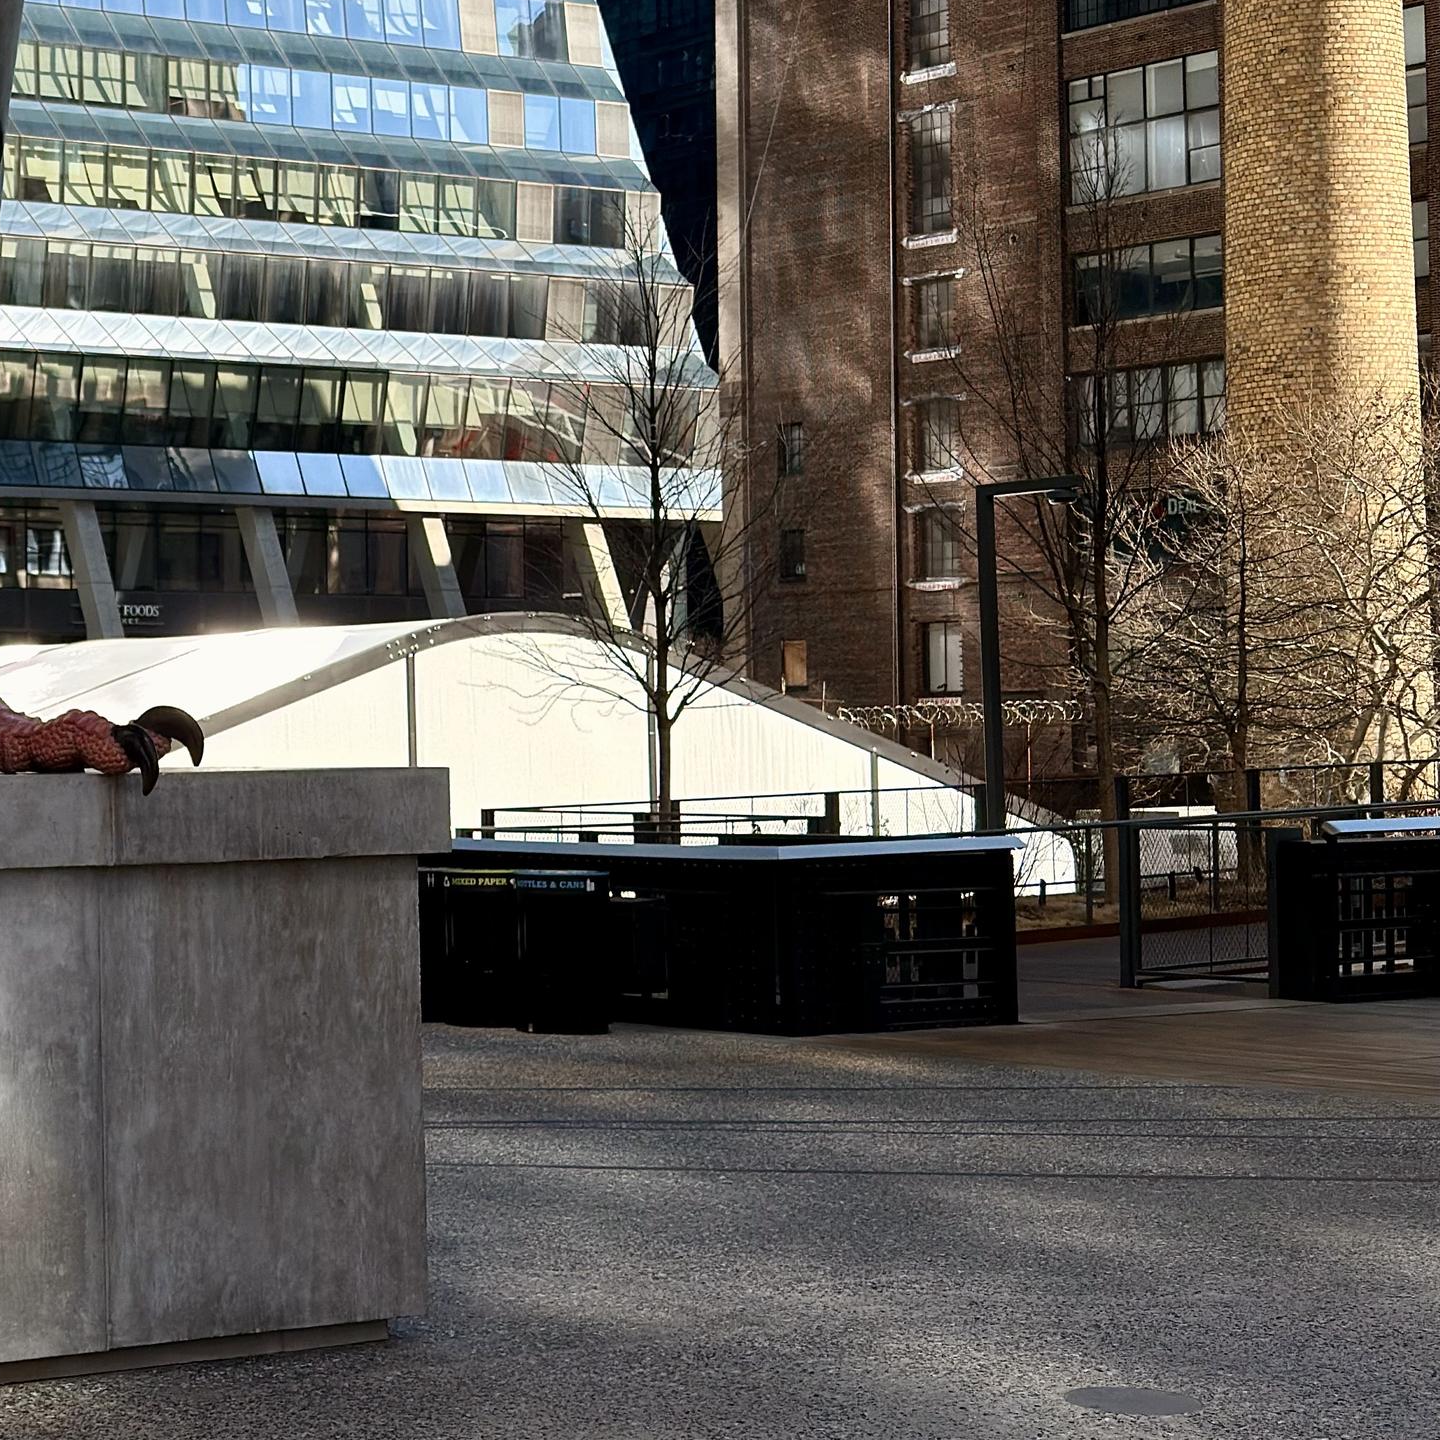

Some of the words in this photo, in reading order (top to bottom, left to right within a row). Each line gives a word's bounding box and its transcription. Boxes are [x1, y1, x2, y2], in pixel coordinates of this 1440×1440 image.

[123, 604, 160, 616] FOODS
[451, 877, 477, 886] MIXED
[478, 877, 508, 886] PAPER
[550, 880, 557, 888] &
[559, 880, 585, 889] CANS
